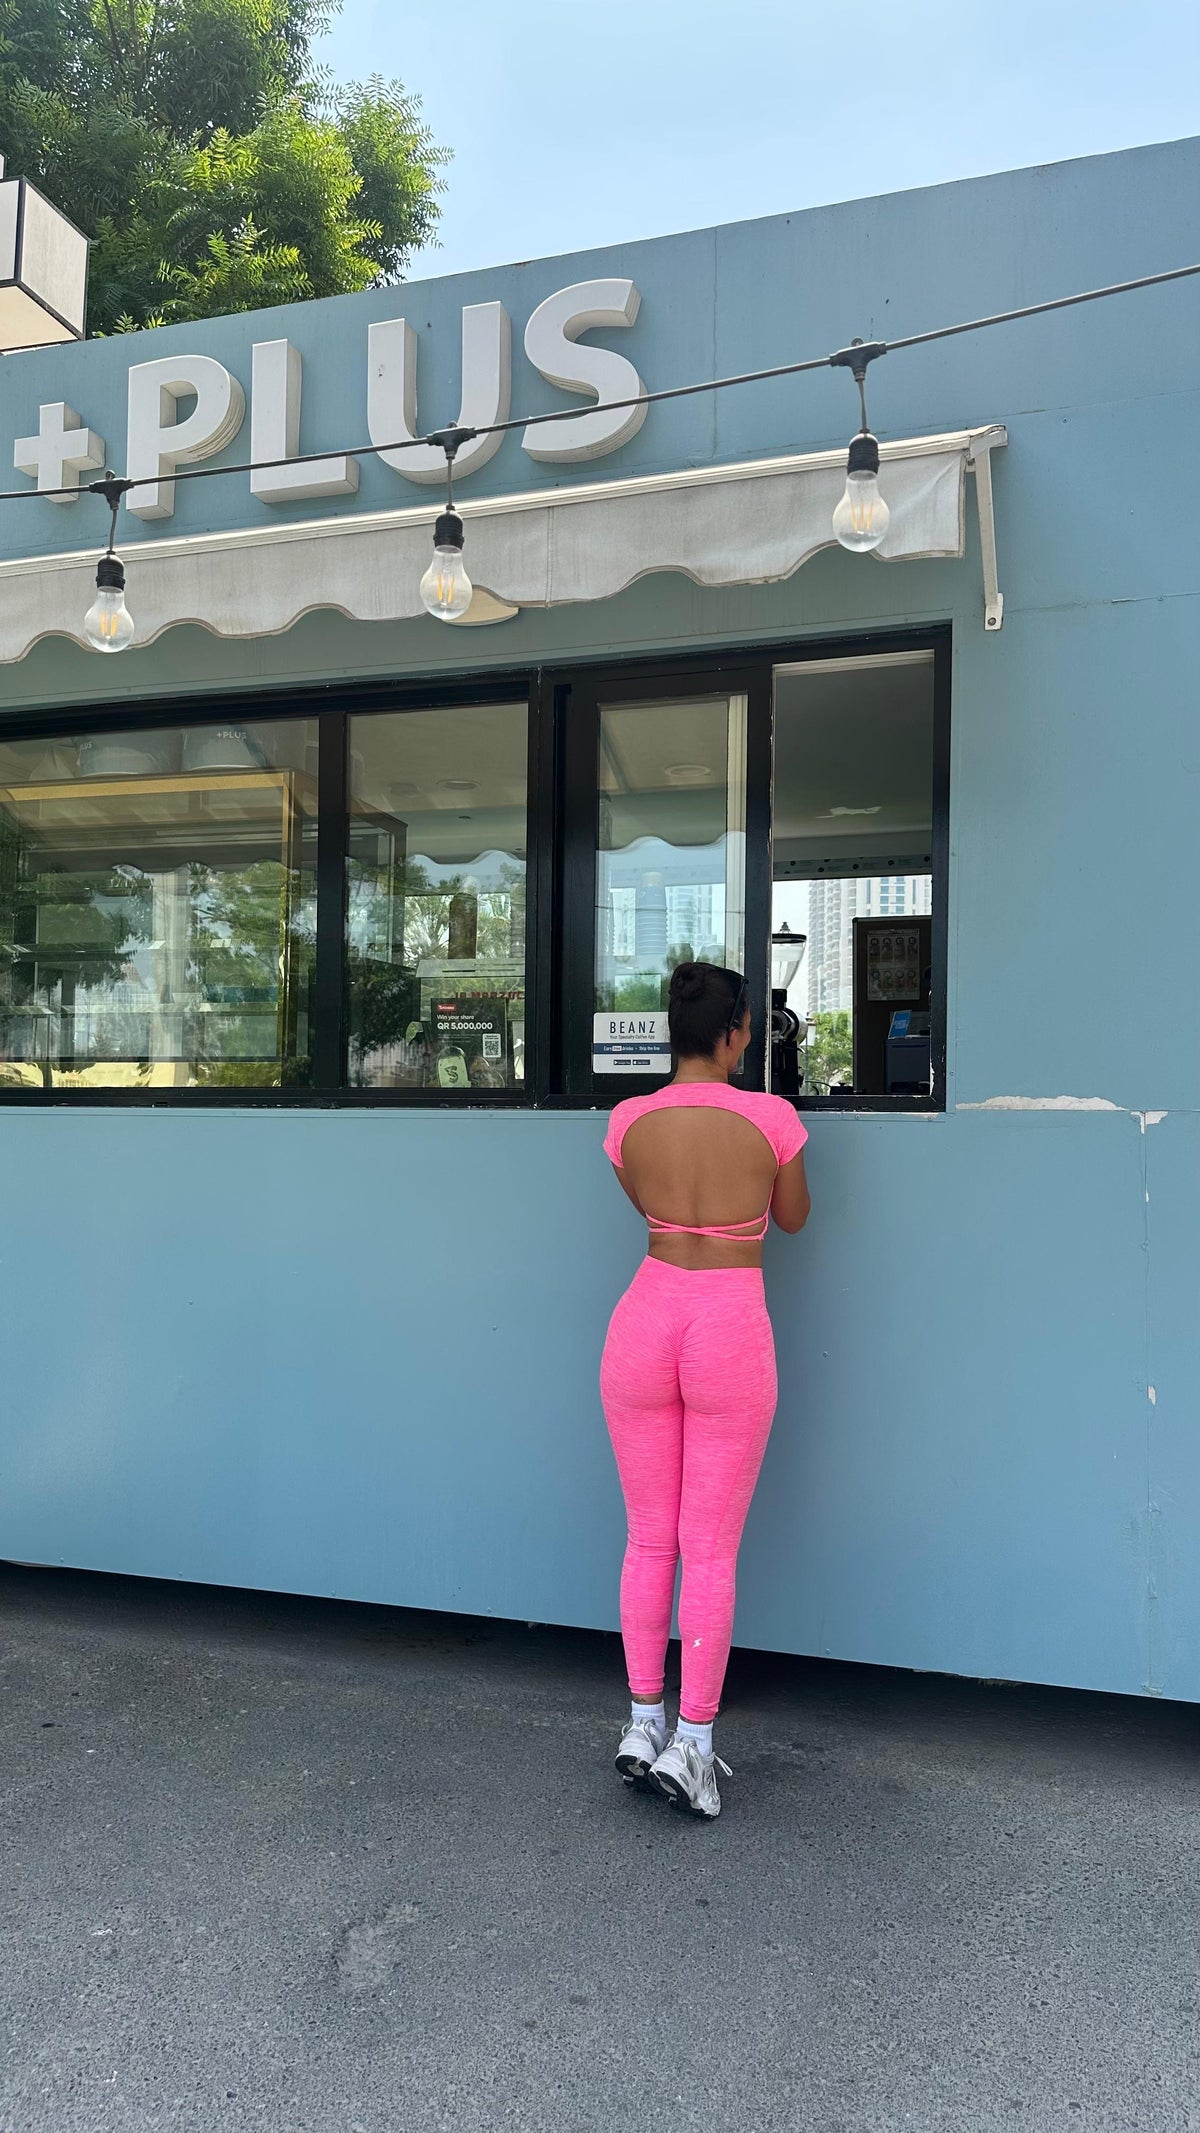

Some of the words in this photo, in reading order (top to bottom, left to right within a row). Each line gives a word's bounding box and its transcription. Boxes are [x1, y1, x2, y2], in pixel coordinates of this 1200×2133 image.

[437, 1022, 449, 1030] QR
[451, 1022, 493, 1030] 5,000,000
[610, 1021, 655, 1034] BEANZ
